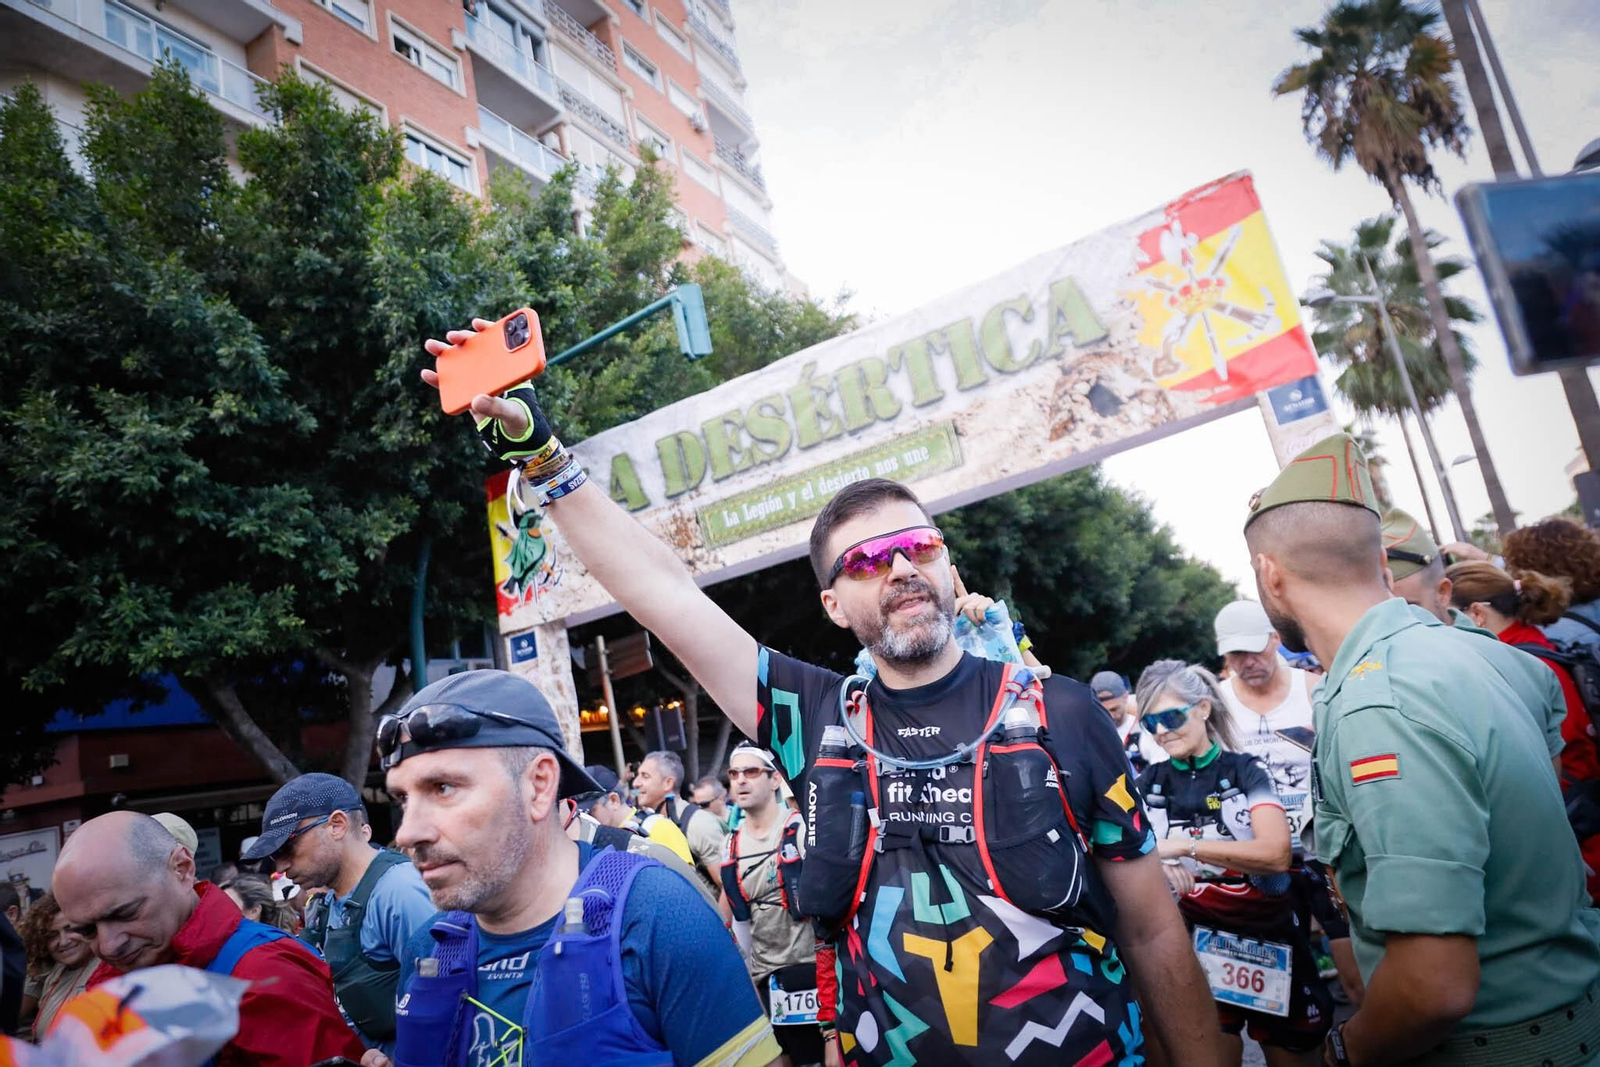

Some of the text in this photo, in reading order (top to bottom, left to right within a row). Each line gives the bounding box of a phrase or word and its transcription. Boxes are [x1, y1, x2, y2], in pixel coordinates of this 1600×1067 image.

[609, 275, 1109, 511] A DESÉRTICA
[722, 446, 929, 527] La Legión y el desierto nos une
[897, 726, 941, 737] FASTER
[270, 812, 298, 826] SALOMON
[808, 781, 818, 847] AONIJIE
[889, 811, 955, 823] RUNNING
[487, 972, 525, 980] EVENTS
[1221, 962, 1266, 994] 366
